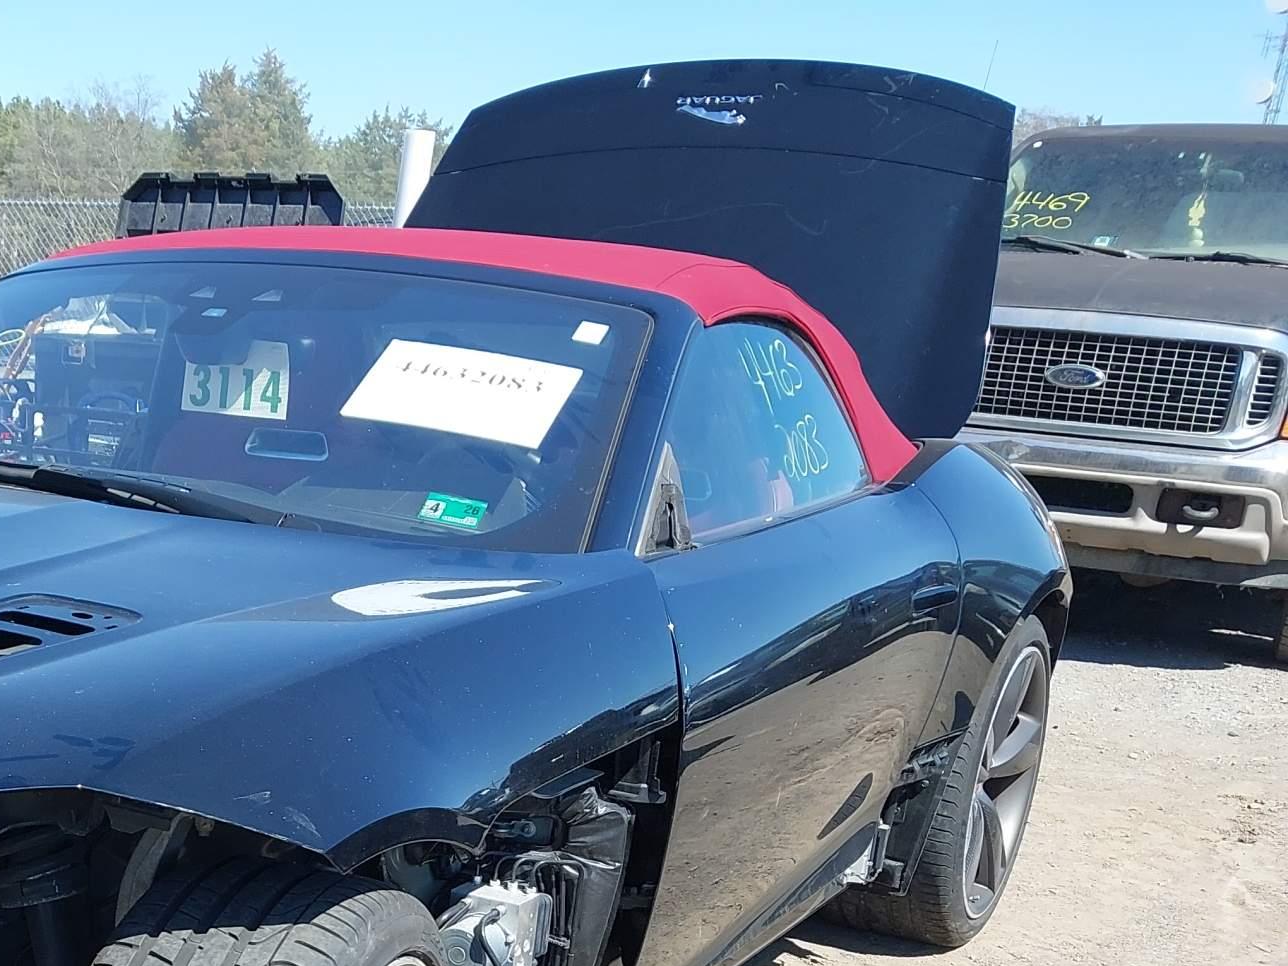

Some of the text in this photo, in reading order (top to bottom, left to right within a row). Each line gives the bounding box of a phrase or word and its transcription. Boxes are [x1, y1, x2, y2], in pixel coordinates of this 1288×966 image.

[676, 95, 763, 105] JAGUAR
[1011, 190, 1090, 212] 4469
[1002, 213, 1073, 229] 3700
[737, 337, 803, 416] 4463
[189, 365, 282, 413] 3114
[429, 502, 481, 516] 4 26
